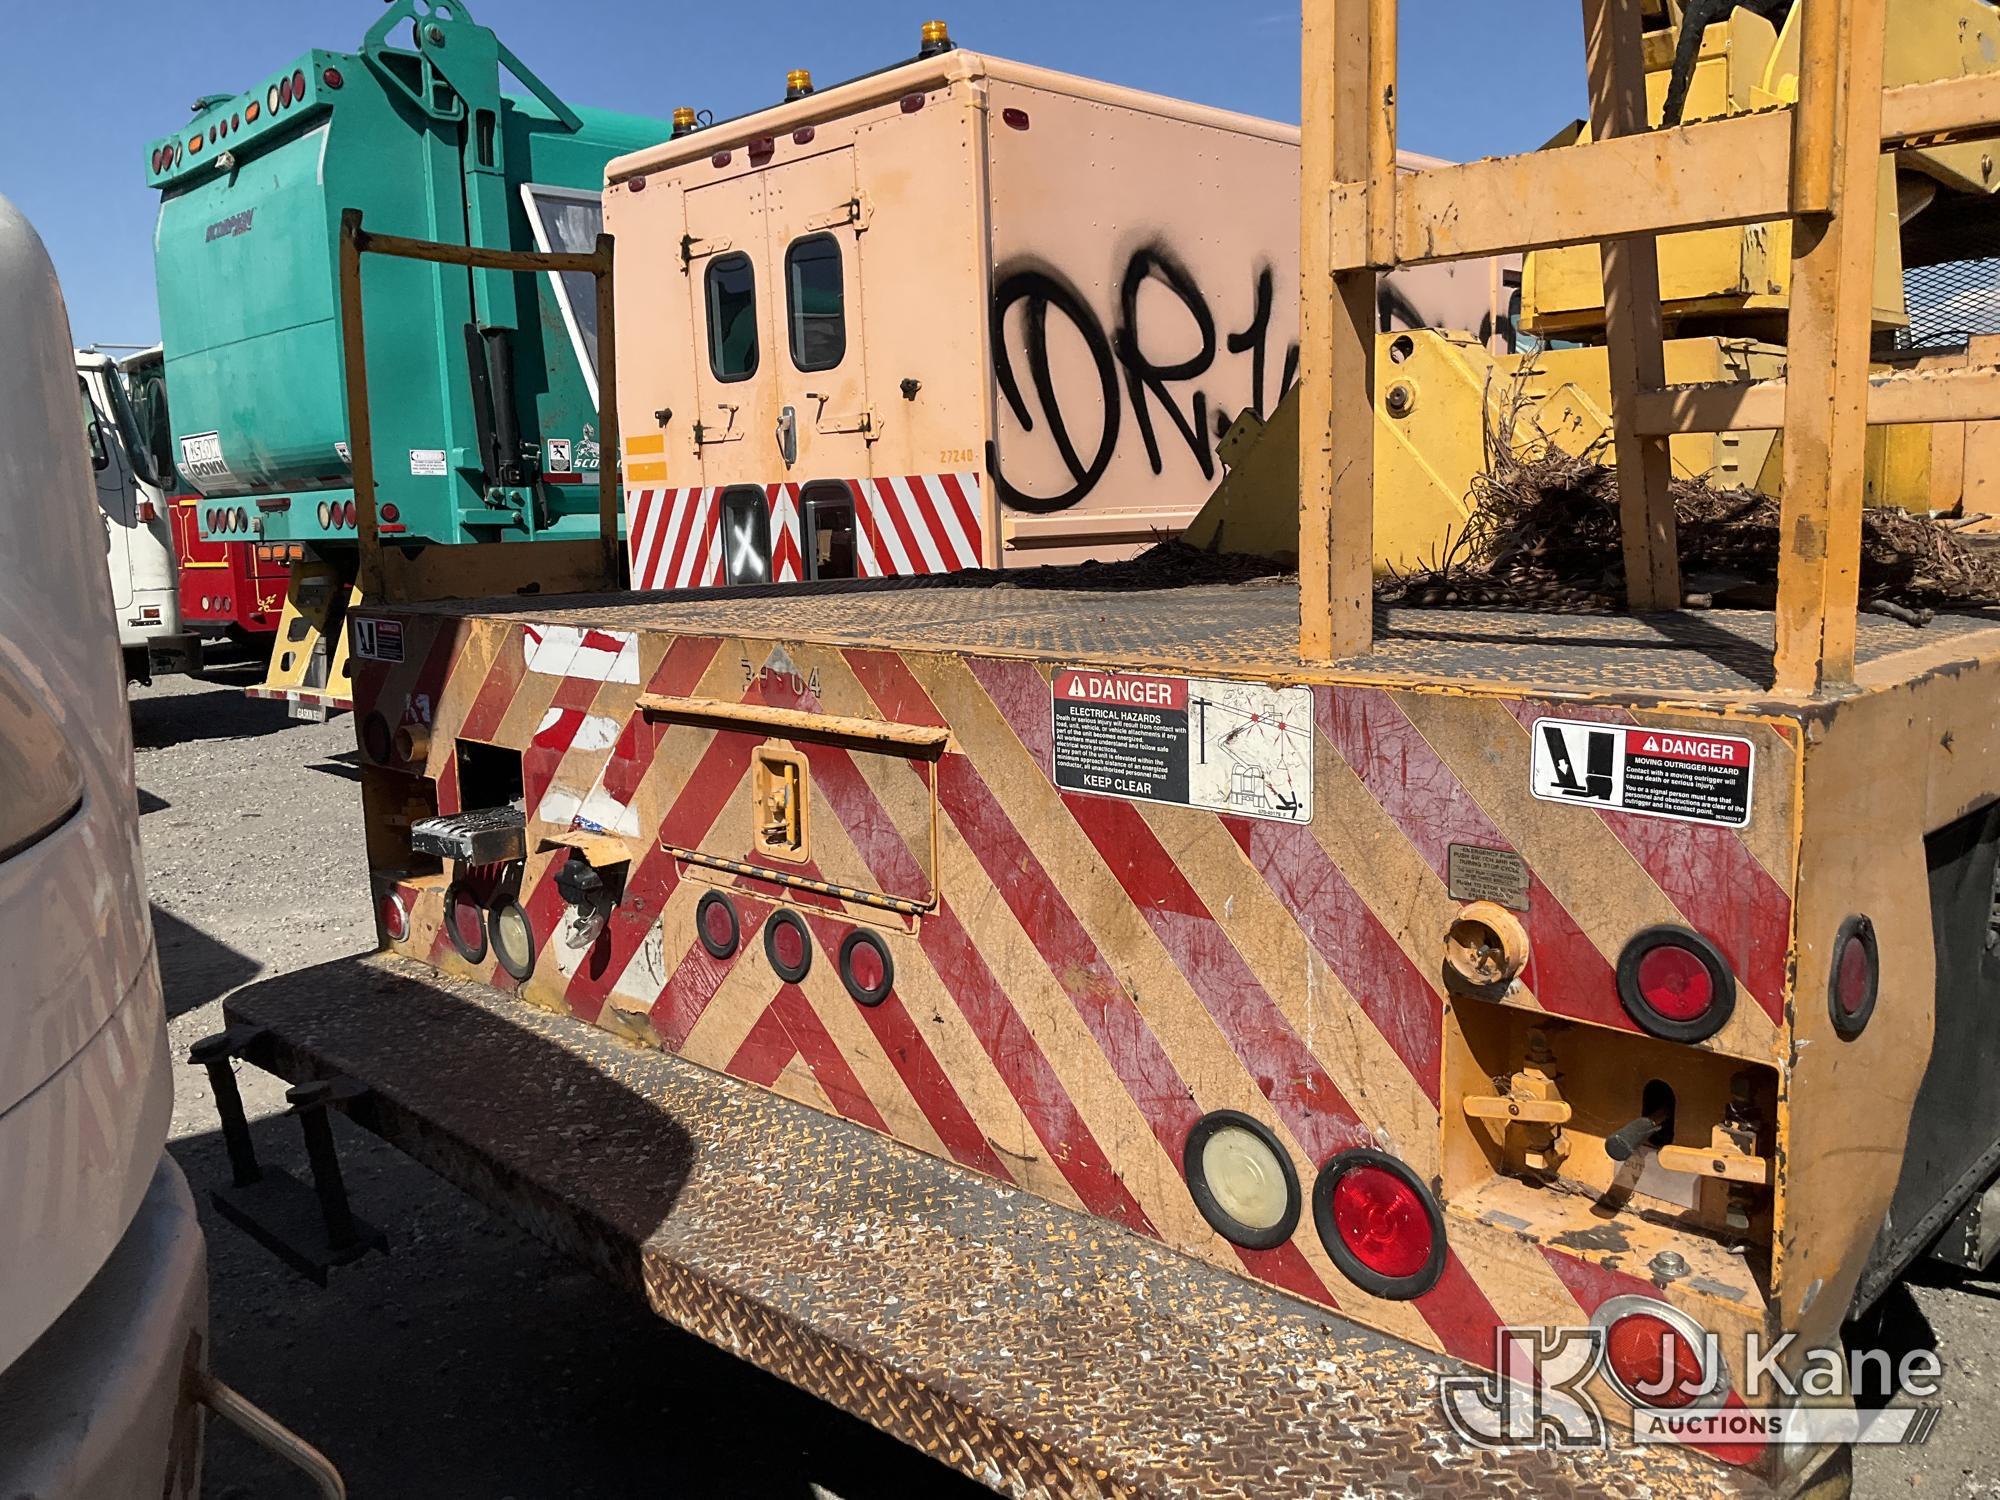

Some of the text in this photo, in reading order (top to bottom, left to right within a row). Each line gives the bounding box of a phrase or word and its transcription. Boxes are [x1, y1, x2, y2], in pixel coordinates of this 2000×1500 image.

[940, 449, 973, 463] 27240
[192, 460, 228, 475] DOWN
[1089, 678, 1171, 704] DANGER
[1070, 707, 1161, 723] ELECTRICAL HAZARDS
[1098, 719, 1112, 727] injury
[1082, 724, 1100, 732] vehicle,
[1128, 728, 1160, 738] attachments
[1167, 733, 1176, 741] any
[1118, 734, 1143, 743] energized.
[1065, 735, 1083, 743] workers
[1099, 739, 1127, 748] understand
[1140, 743, 1155, 751] follow
[1093, 745, 1117, 753] practices.
[1662, 739, 1734, 760] DANGER
[1081, 757, 1103, 765] approach
[1142, 764, 1168, 773] energized
[1115, 754, 1136, 762] elevated
[1634, 757, 1739, 775] MOVING OUTRIGGER HAZARD
[1057, 760, 1083, 769] conductor,
[1092, 765, 1124, 774] unauthorized
[1126, 769, 1151, 778] personnel
[1153, 772, 1166, 780] must
[1626, 766, 1649, 774] Contact
[1670, 772, 1692, 780] moving
[1694, 775, 1723, 784] outrigger
[1084, 774, 1151, 794] KEEP CLEAR
[1645, 775, 1662, 783] death
[1671, 779, 1694, 787] serious
[1696, 782, 1714, 790] injury.
[1625, 792, 1652, 800] personnel
[1665, 796, 1700, 806] obstructions
[1712, 802, 1726, 810] clear
